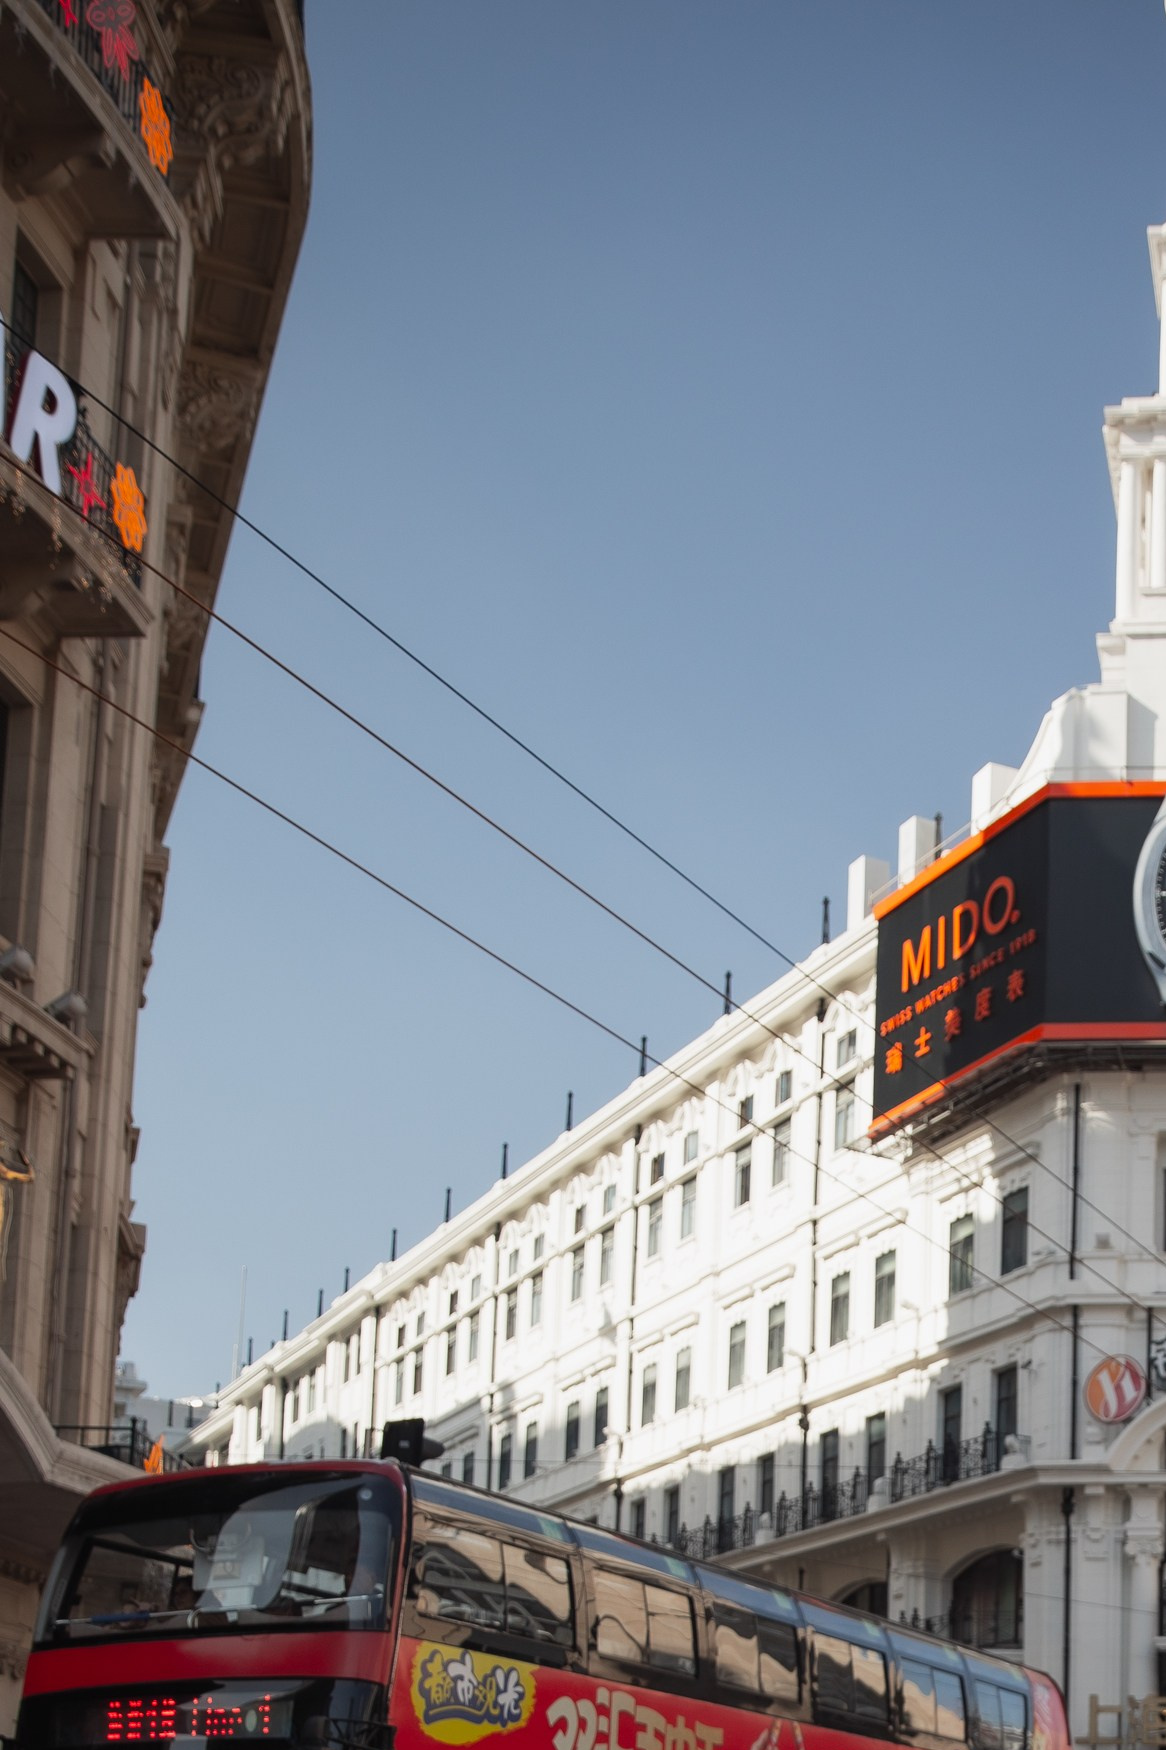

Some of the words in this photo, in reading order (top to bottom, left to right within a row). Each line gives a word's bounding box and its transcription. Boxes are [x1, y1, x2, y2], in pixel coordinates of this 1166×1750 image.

[0, 325, 77, 495] R
[901, 876, 1015, 993] MIDO
[885, 968, 1025, 1075] 瑞士美度表
